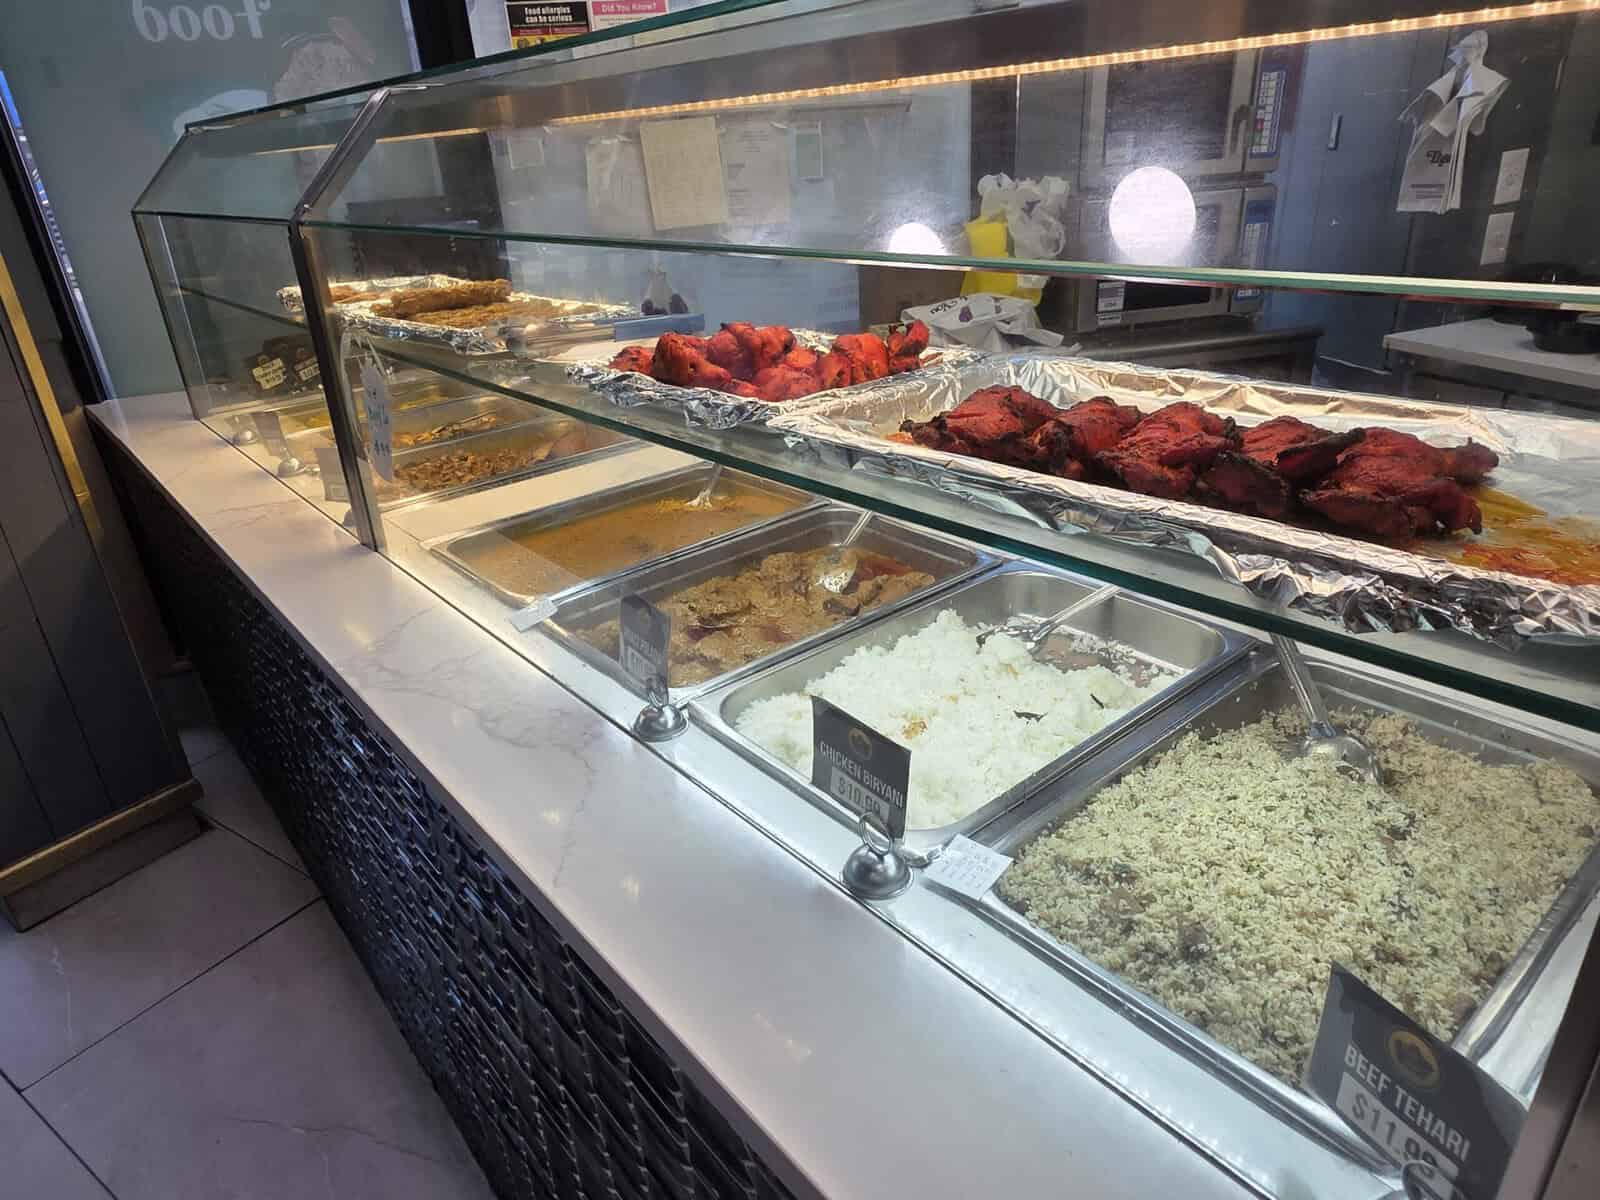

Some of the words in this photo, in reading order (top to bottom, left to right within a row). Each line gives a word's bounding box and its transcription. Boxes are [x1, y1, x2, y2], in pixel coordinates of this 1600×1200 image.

[820, 741, 861, 780] CHICKEN
[863, 769, 904, 809] BIRYANI
[1344, 1043, 1392, 1094] BEEF
[1395, 1085, 1471, 1162] TEHARI
